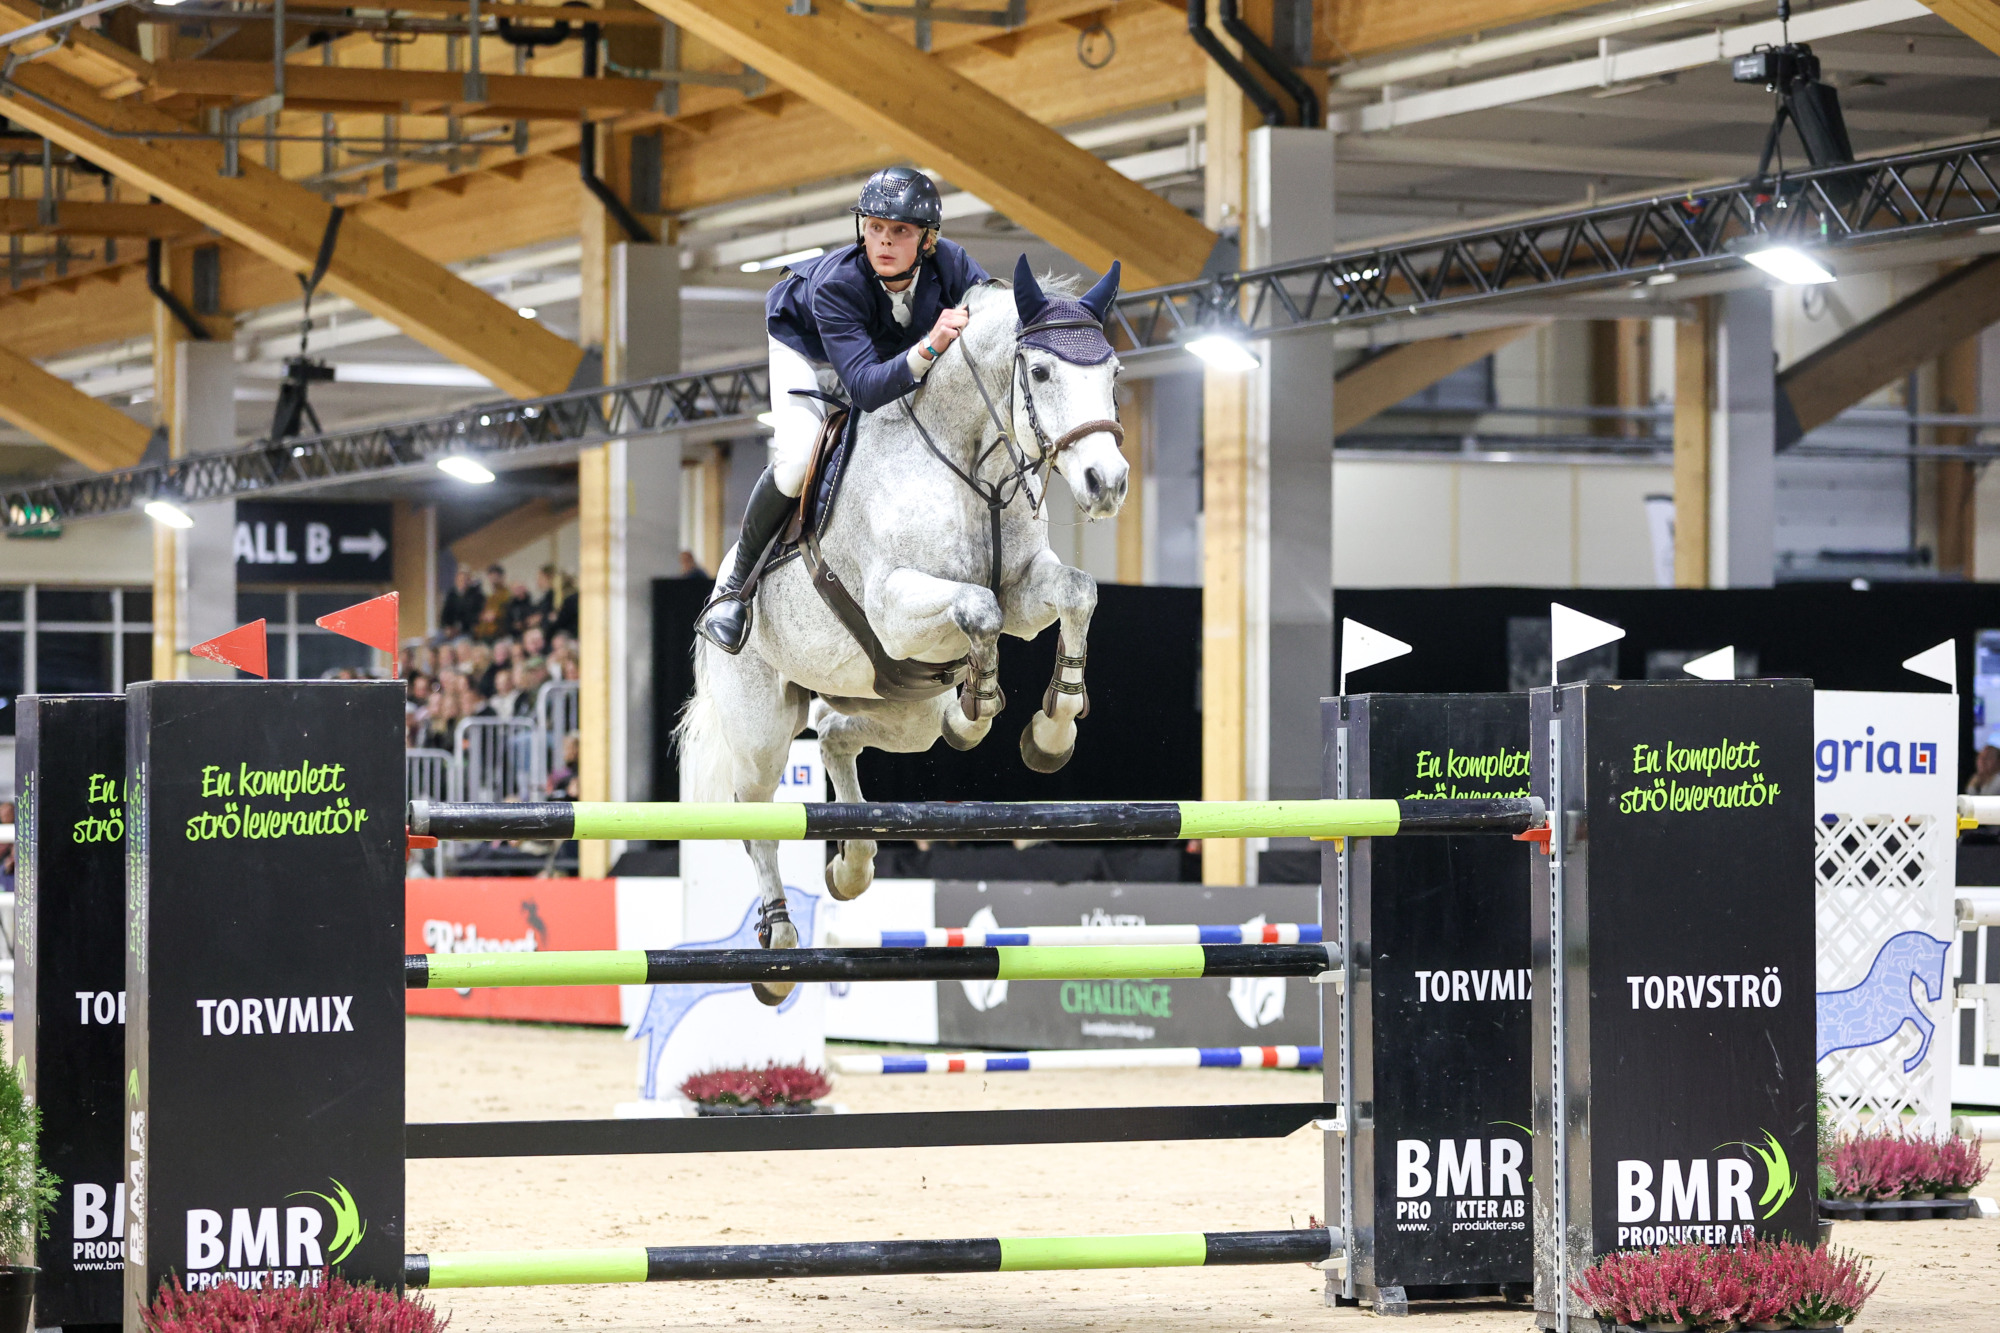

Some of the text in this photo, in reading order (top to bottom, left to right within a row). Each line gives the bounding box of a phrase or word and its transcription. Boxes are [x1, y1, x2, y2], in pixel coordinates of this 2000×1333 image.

[306, 521, 332, 564] B
[1416, 750, 1443, 778] En
[1633, 738, 1760, 777] En komplett
[88, 773, 118, 804] En
[202, 759, 346, 802] En komplett
[1060, 980, 1172, 1018] CHALLENGE
[1627, 966, 1782, 1010] TORVSTRÖ
[196, 995, 354, 1036] TORVMIX
[1397, 1139, 1525, 1198] BMR
[1502, 1200, 1525, 1218] AB
[1617, 1158, 1755, 1223] BMR
[187, 1206, 324, 1269] BMR
